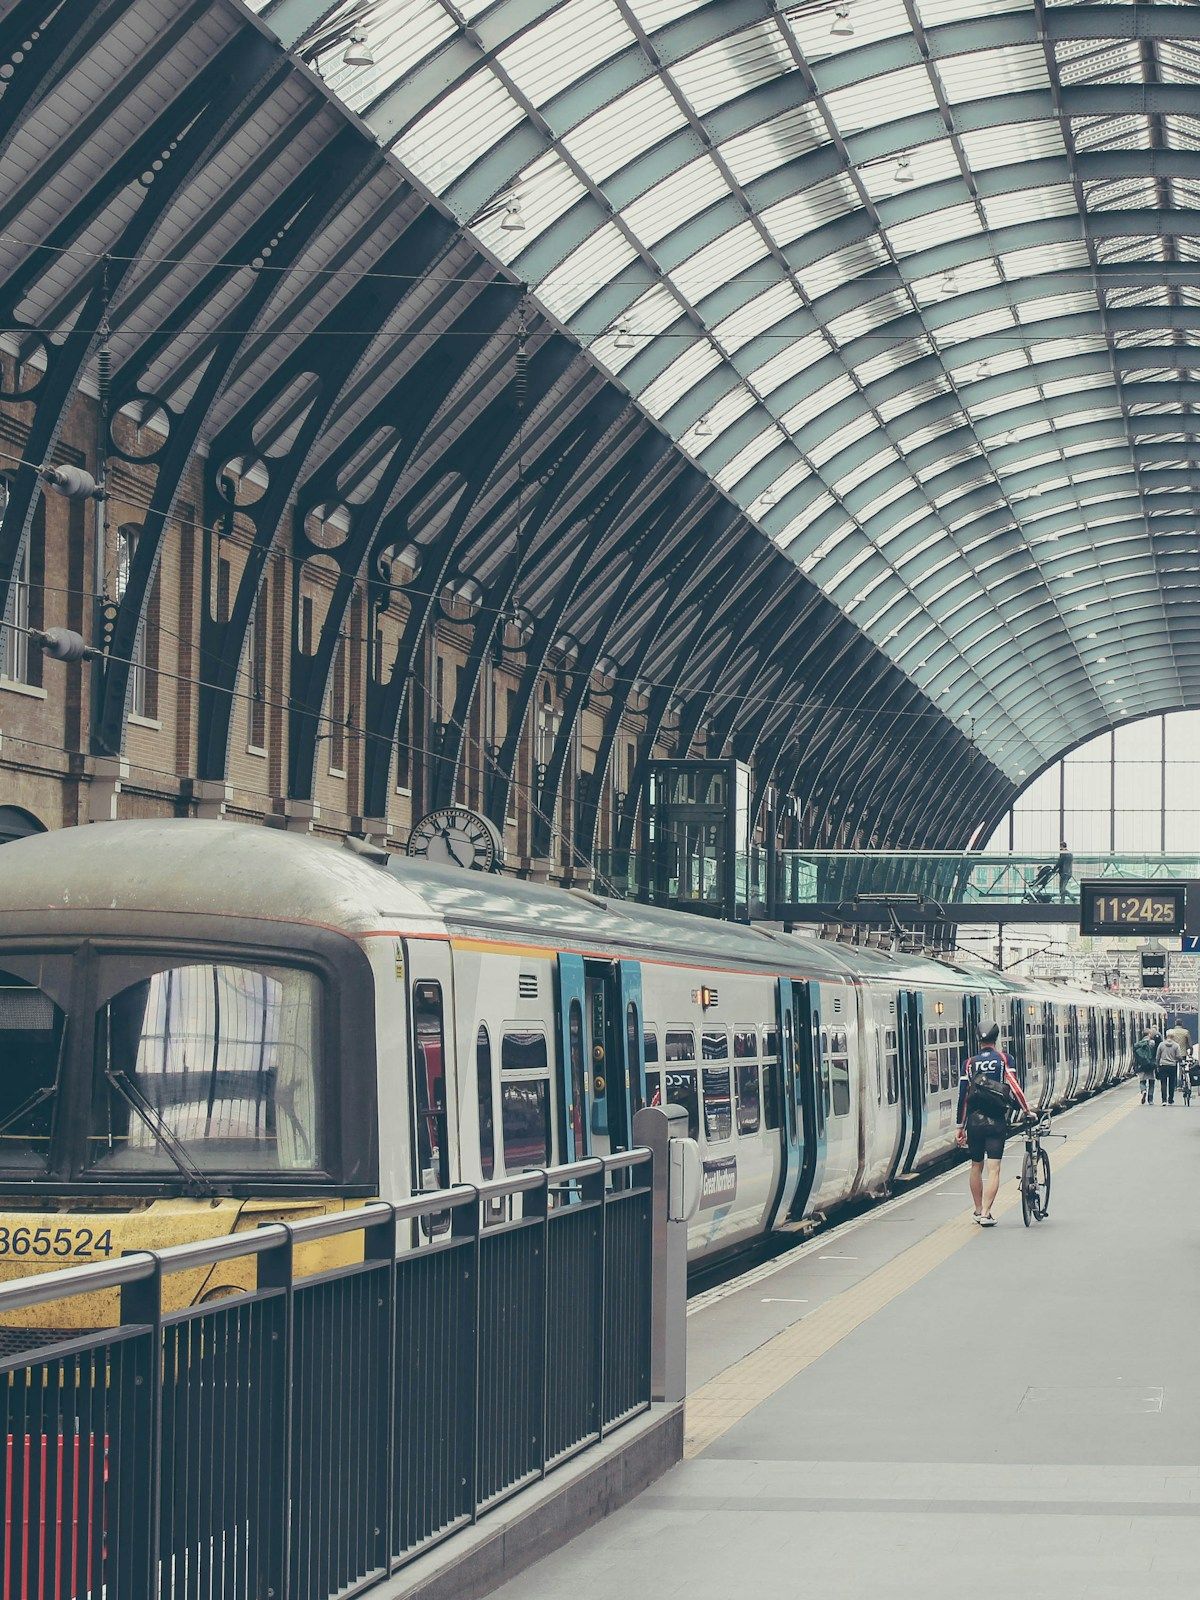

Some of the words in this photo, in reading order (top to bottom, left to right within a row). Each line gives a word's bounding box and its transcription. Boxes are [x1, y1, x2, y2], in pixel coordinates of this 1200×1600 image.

[1189, 936, 1199, 948] 7
[975, 1060, 998, 1071] TCC
[703, 1172, 716, 1196] Great
[715, 1168, 735, 1192] Northern
